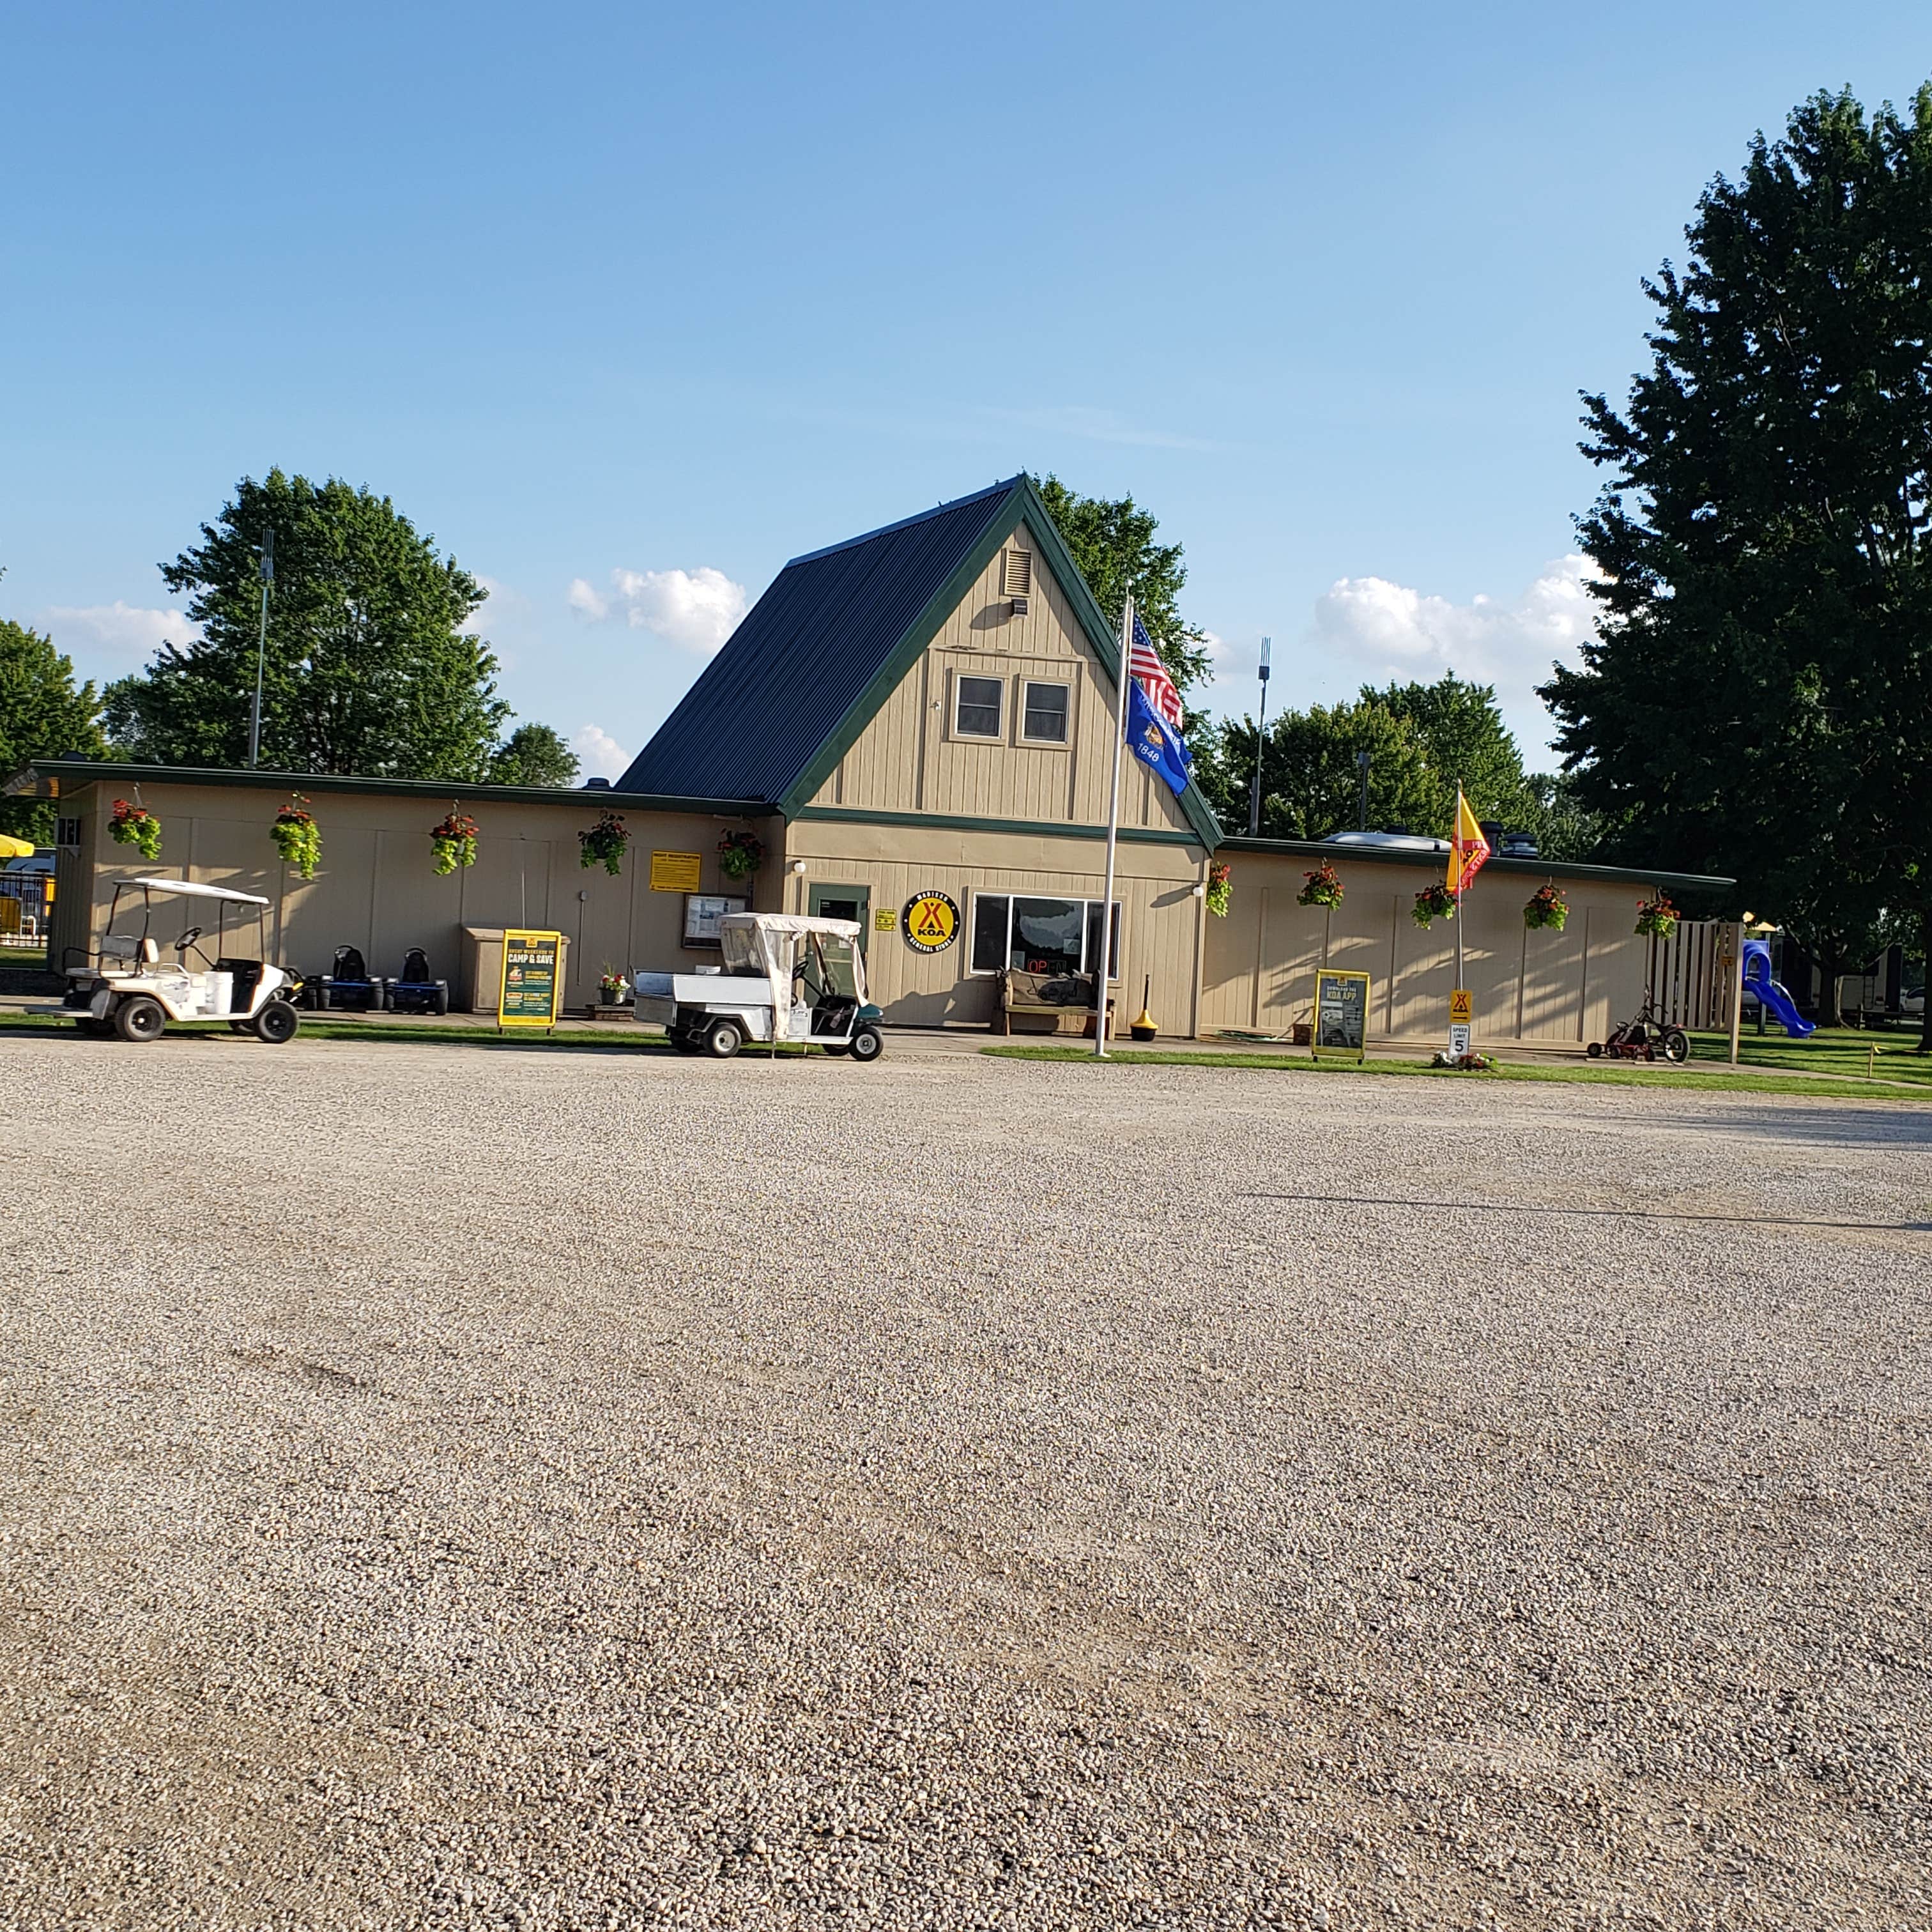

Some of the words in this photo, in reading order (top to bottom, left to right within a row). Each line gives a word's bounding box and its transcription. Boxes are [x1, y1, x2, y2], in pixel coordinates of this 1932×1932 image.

[1138, 743, 1159, 762] 1848
[508, 953, 528, 963] CAMP
[529, 954, 535, 964] &
[536, 954, 555, 965] SAVE
[1342, 992, 1356, 1001] APP
[1455, 1040, 1464, 1052] 5
